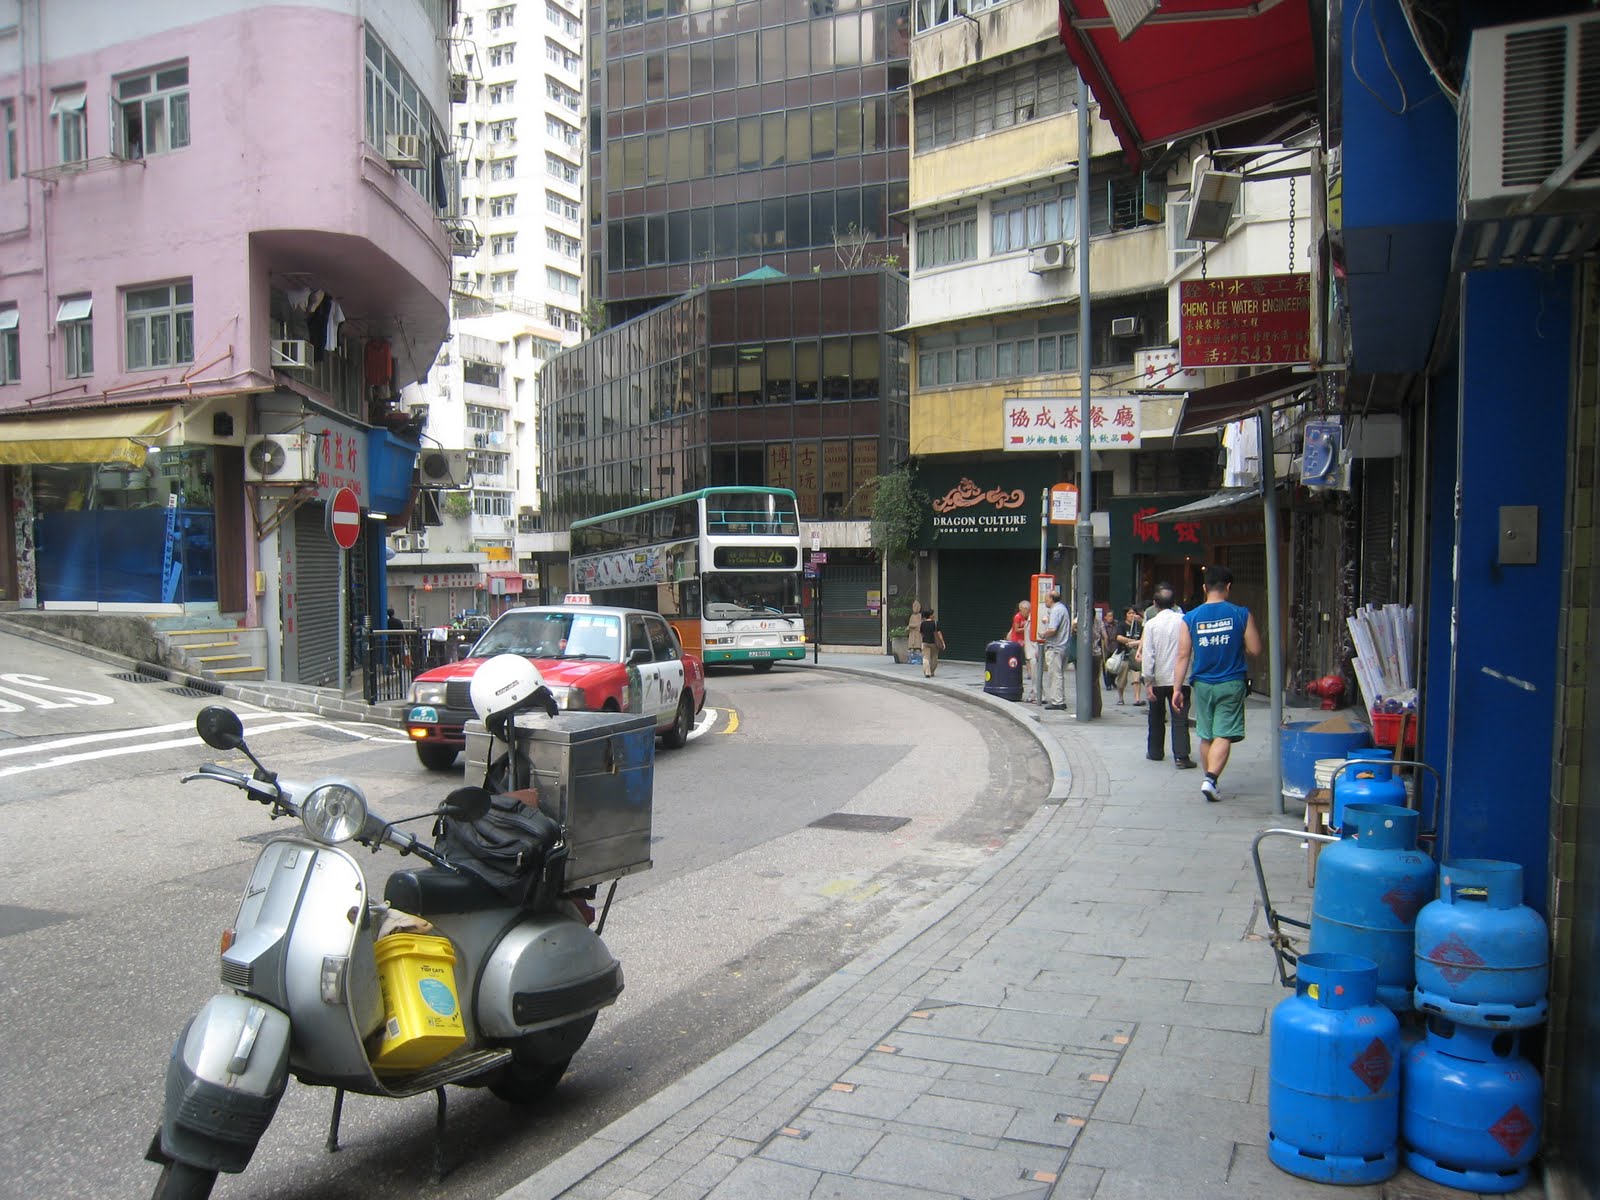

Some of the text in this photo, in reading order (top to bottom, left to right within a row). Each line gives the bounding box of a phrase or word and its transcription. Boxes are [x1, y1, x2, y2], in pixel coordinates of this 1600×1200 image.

[1182, 297, 1310, 316] CHENG LEE WATER ENGINEERIN
[1282, 343, 1310, 361] 718
[1009, 405, 1136, 429] 協成茶餐廳
[933, 515, 1027, 526] DRAGON CULTURE
[768, 551, 784, 564] 26
[1198, 634, 1230, 647] 港利行
